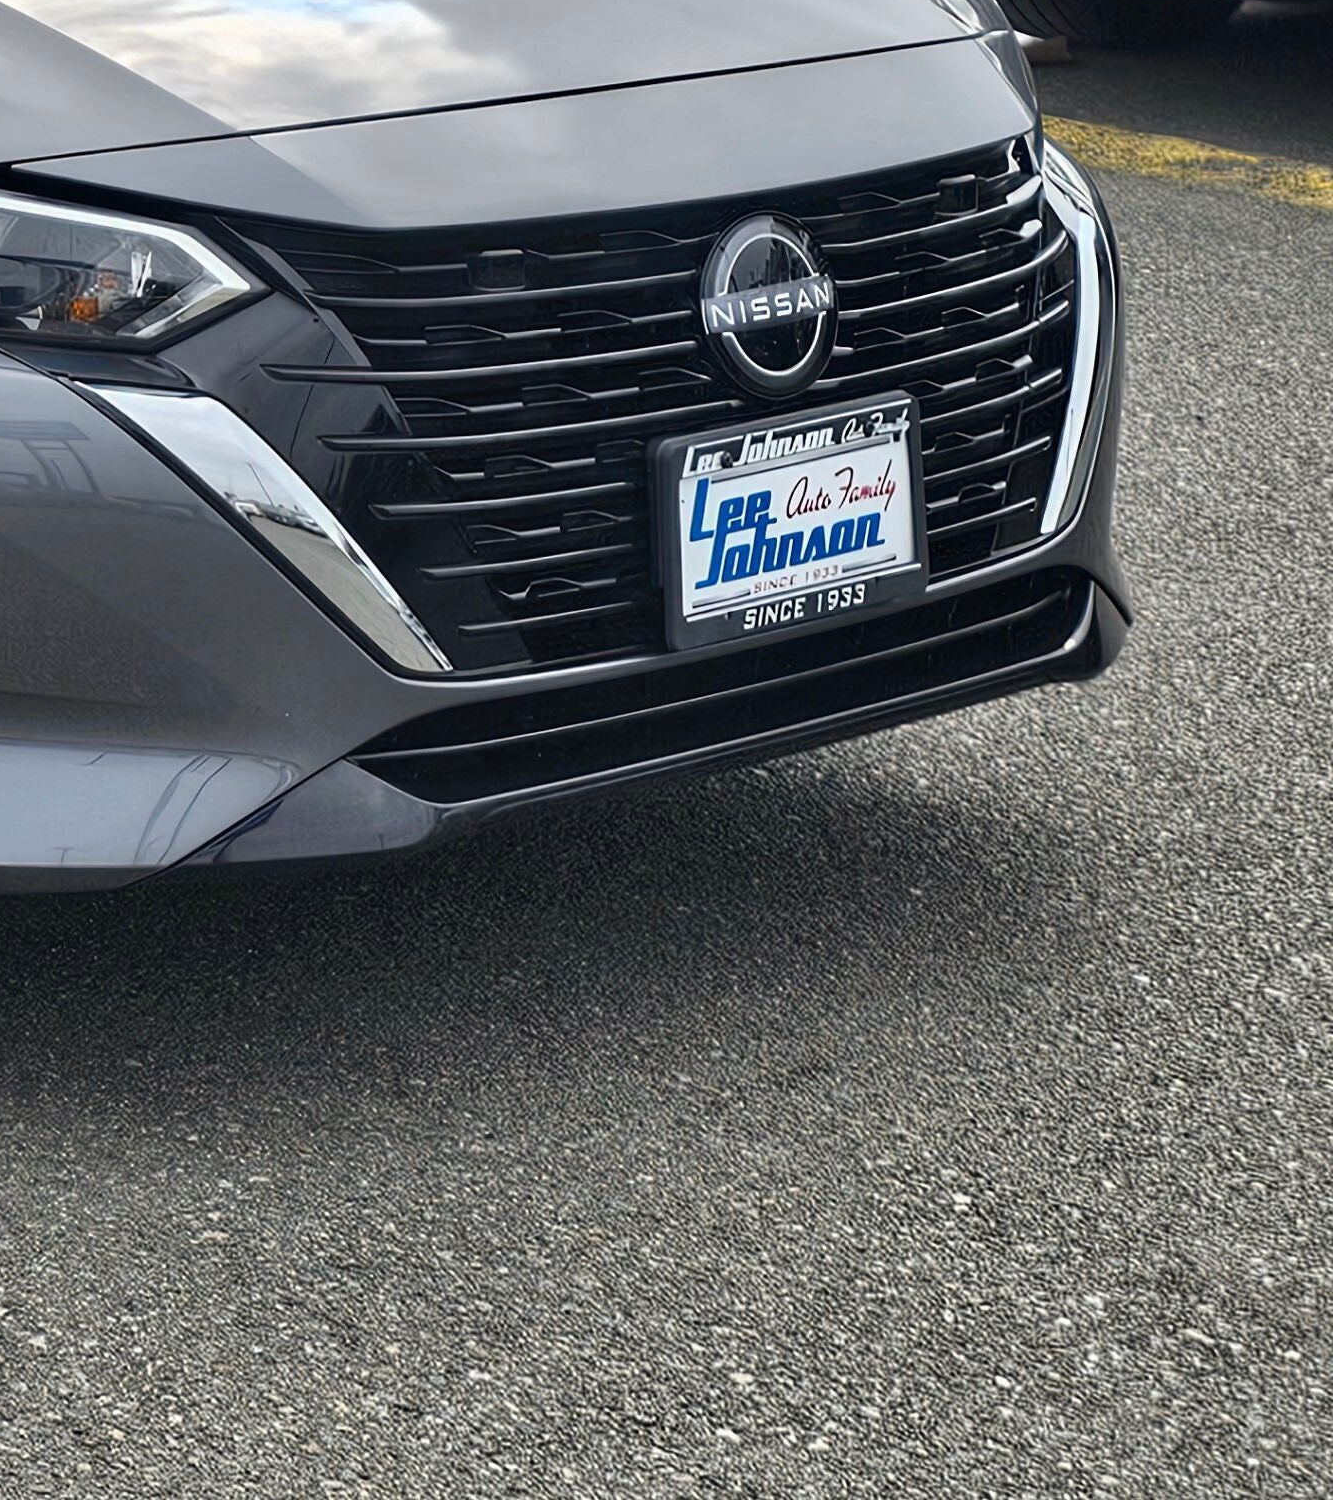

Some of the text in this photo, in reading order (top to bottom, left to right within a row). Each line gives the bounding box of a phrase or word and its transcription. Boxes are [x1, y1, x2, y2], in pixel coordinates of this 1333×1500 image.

[711, 281, 830, 328] NISSAN
[733, 428, 835, 467] Johnson
[689, 458, 896, 542] Lee Auto Family
[694, 510, 886, 590] Johnson
[753, 564, 840, 595] SINCE 1933
[743, 584, 866, 630] SINCE 1933
